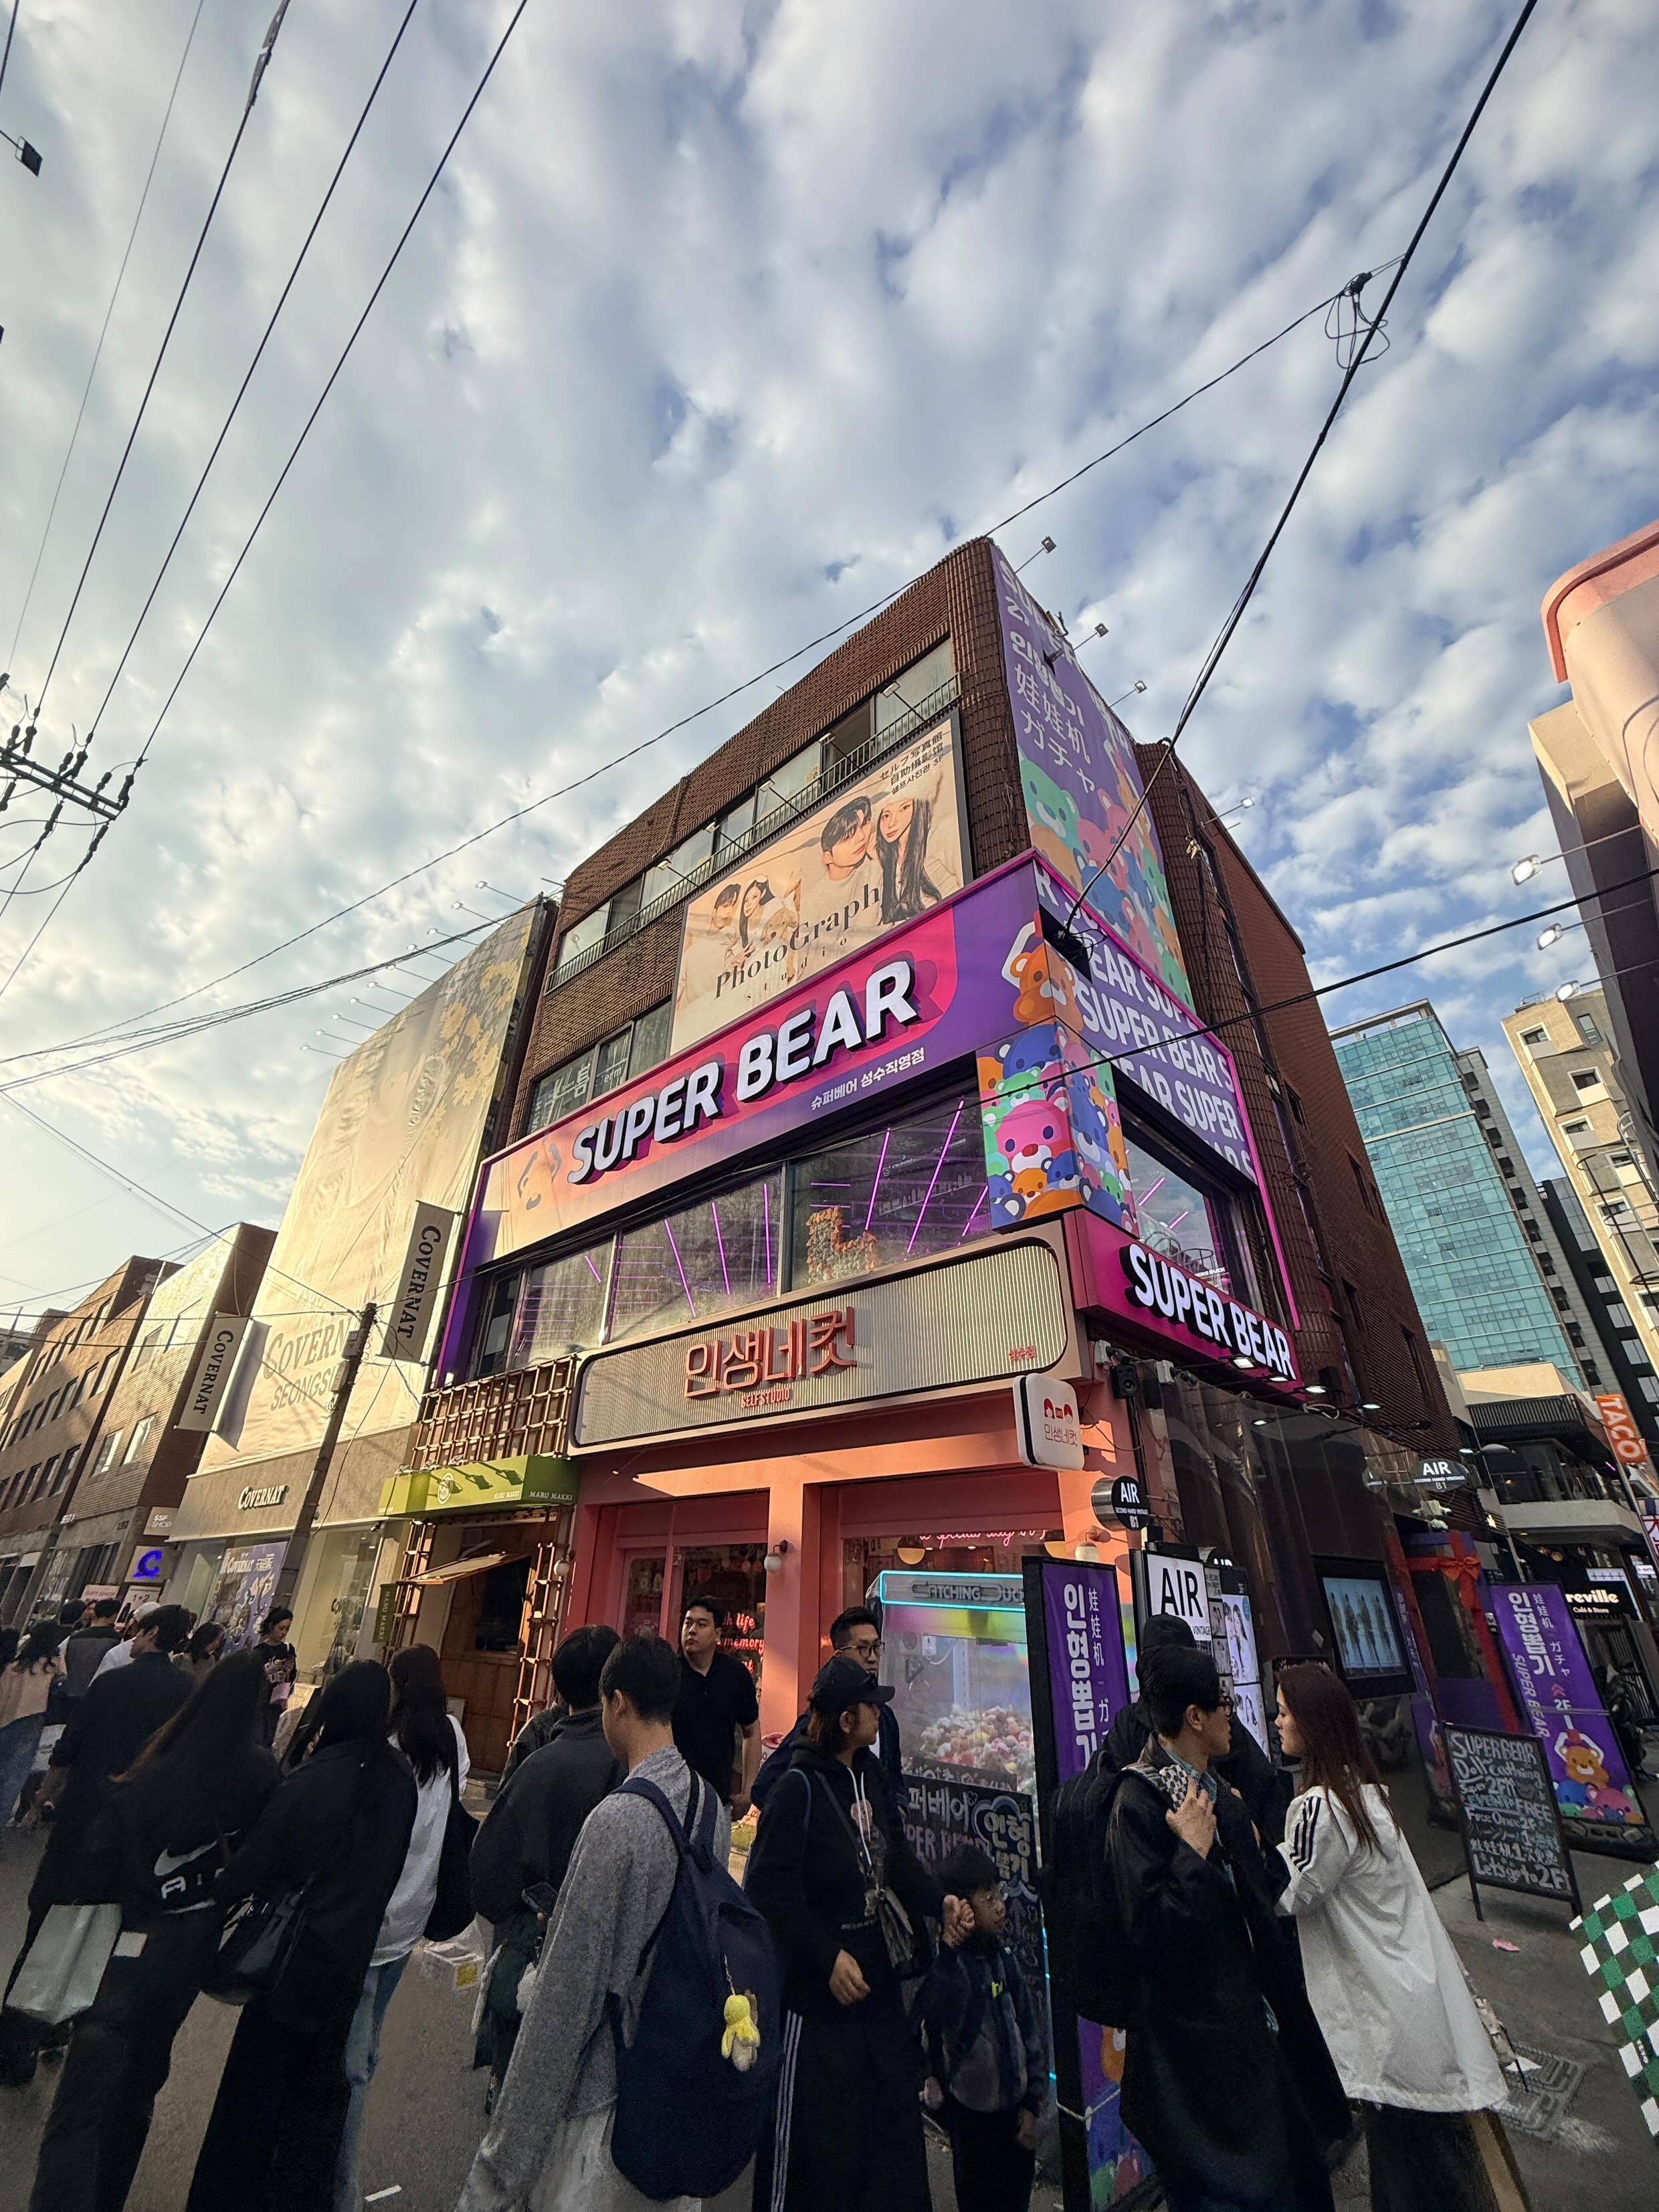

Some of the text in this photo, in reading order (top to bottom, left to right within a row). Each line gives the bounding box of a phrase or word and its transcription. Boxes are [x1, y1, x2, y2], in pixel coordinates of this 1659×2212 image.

[1010, 631, 1085, 727] 인형뽑기
[1014, 663, 1091, 765] 娃娃机
[891, 754, 944, 795] 셀프사진관 3F
[1020, 709, 1095, 794] ガチャ
[713, 883, 881, 1000] PhotoGraph
[746, 937, 848, 1000] studio
[1075, 982, 1165, 1059] SUPER
[1164, 1025, 1216, 1086] BEAR
[567, 959, 920, 1185] SUPER BEAR
[811, 1047, 925, 1111] 슈퍼베어 성수직영점
[1175, 1080, 1246, 1141] SUPER
[397, 1225, 442, 1338] COVERNAT
[1129, 1243, 1297, 1381] SUPER BEAR
[193, 1330, 234, 1414] COVERNAT
[685, 1306, 858, 1398] 인생네컷
[1044, 1423, 1078, 1447] 인생네컷
[1601, 1398, 1640, 1459] TACO
[1120, 1482, 1141, 1504] AIR
[1422, 1462, 1452, 1476] AIR
[1436, 1481, 1448, 1490] B1
[237, 1485, 286, 1510] COVERNAT
[529, 1491, 573, 1501] MARU MAKKI
[1129, 1515, 1139, 1528] B1
[1161, 1567, 1204, 1618] AIR
[1533, 1593, 1555, 1629] 娃娃机
[723, 1637, 765, 1656] memory
[736, 1612, 756, 1635] life
[1088, 1587, 1104, 1667] 娃娃机
[1191, 1625, 1211, 1636] VINTAGE
[1508, 1591, 1555, 1676] 인형뽑기
[1550, 1641, 1571, 1676] ガチャ
[1512, 1653, 1551, 1739] SUPER BEAR
[1554, 1699, 1572, 1712] 2F
[1450, 1732, 1537, 1765] SUPER BEAR
[984, 1812, 1031, 1857] 인형
[1515, 1798, 1552, 1823] FREE
